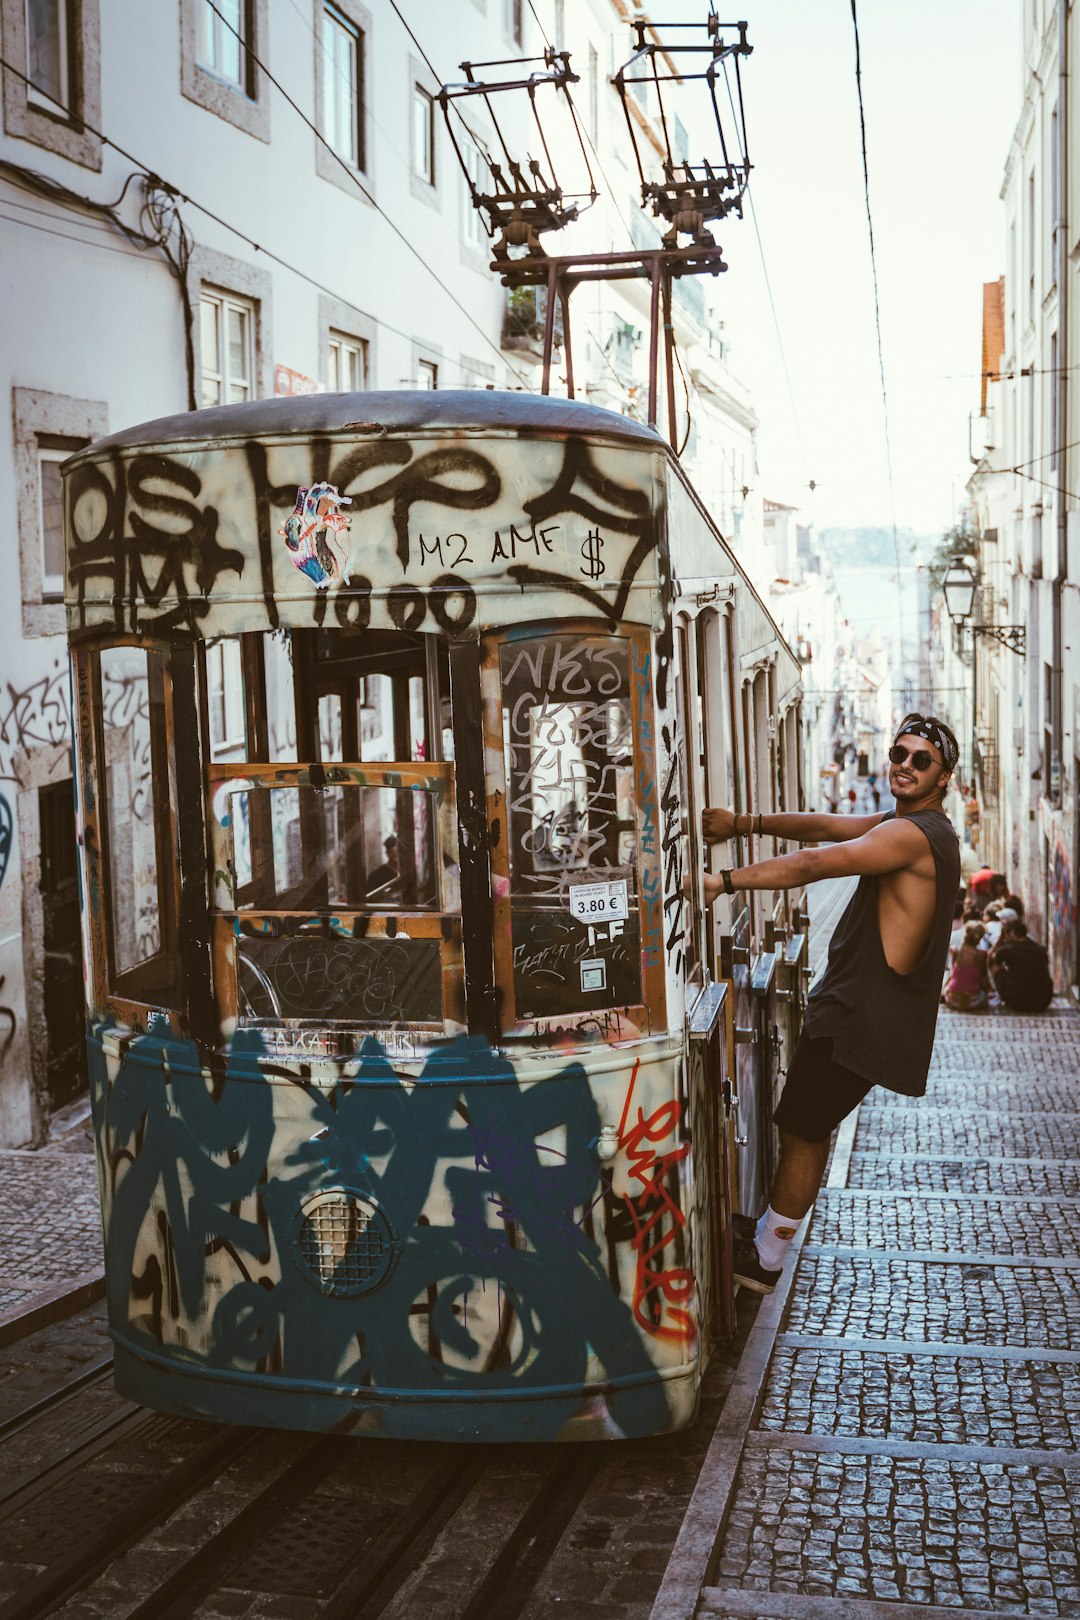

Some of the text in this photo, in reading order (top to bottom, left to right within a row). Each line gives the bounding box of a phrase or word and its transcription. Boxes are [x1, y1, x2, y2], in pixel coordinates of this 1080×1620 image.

[418, 533, 474, 569] M2
[580, 527, 606, 581] $
[578, 897, 618, 914] 3.80 €
